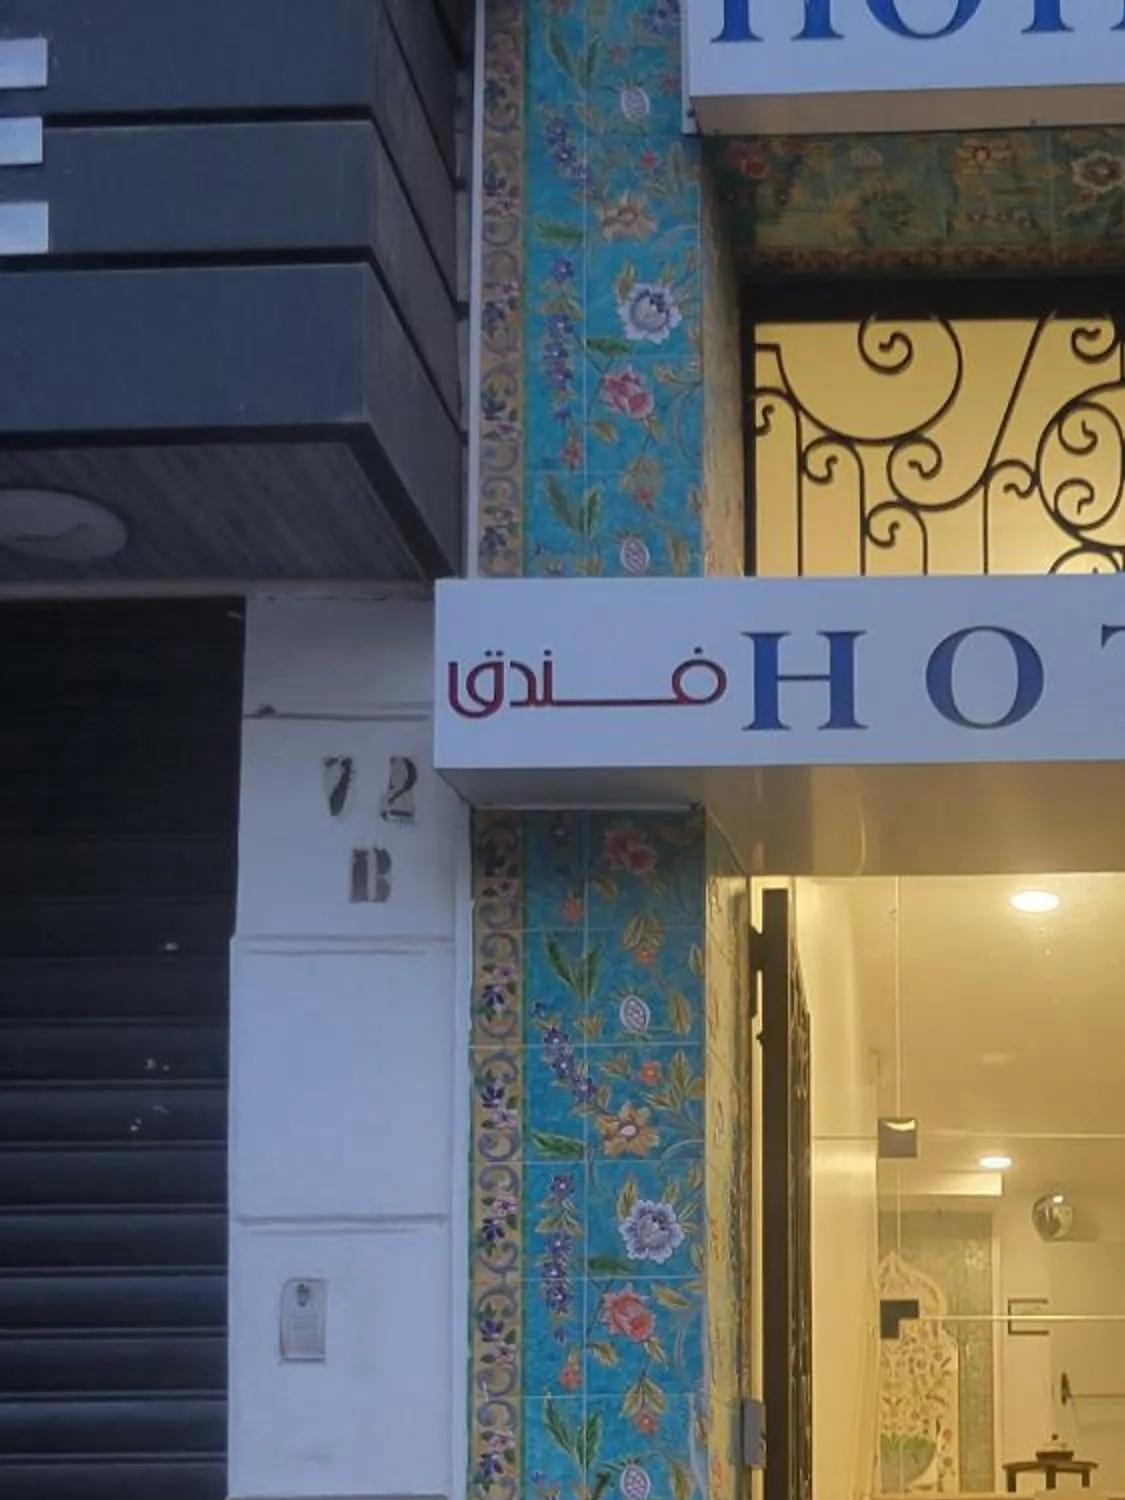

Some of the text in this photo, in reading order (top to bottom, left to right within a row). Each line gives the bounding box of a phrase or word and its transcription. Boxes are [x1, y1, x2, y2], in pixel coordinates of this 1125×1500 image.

[448, 646, 727, 719] فندق
[323, 756, 417, 824] 72
[350, 847, 392, 903] B
